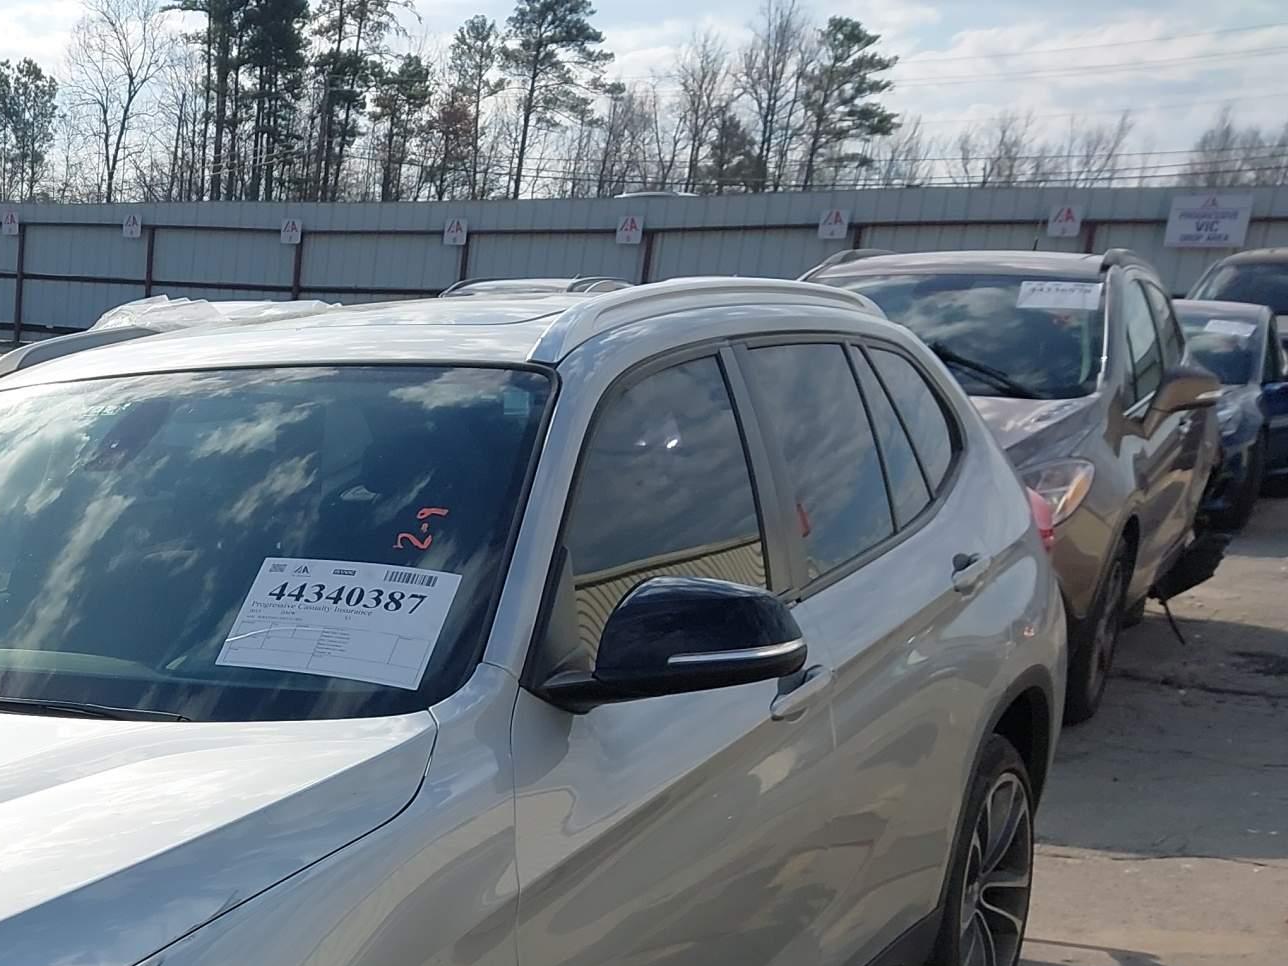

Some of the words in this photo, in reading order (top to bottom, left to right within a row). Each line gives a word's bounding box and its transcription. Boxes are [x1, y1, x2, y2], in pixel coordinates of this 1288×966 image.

[268, 581, 428, 615] 44340387
[298, 603, 330, 613] Casualty
[334, 606, 373, 617] Insurance
